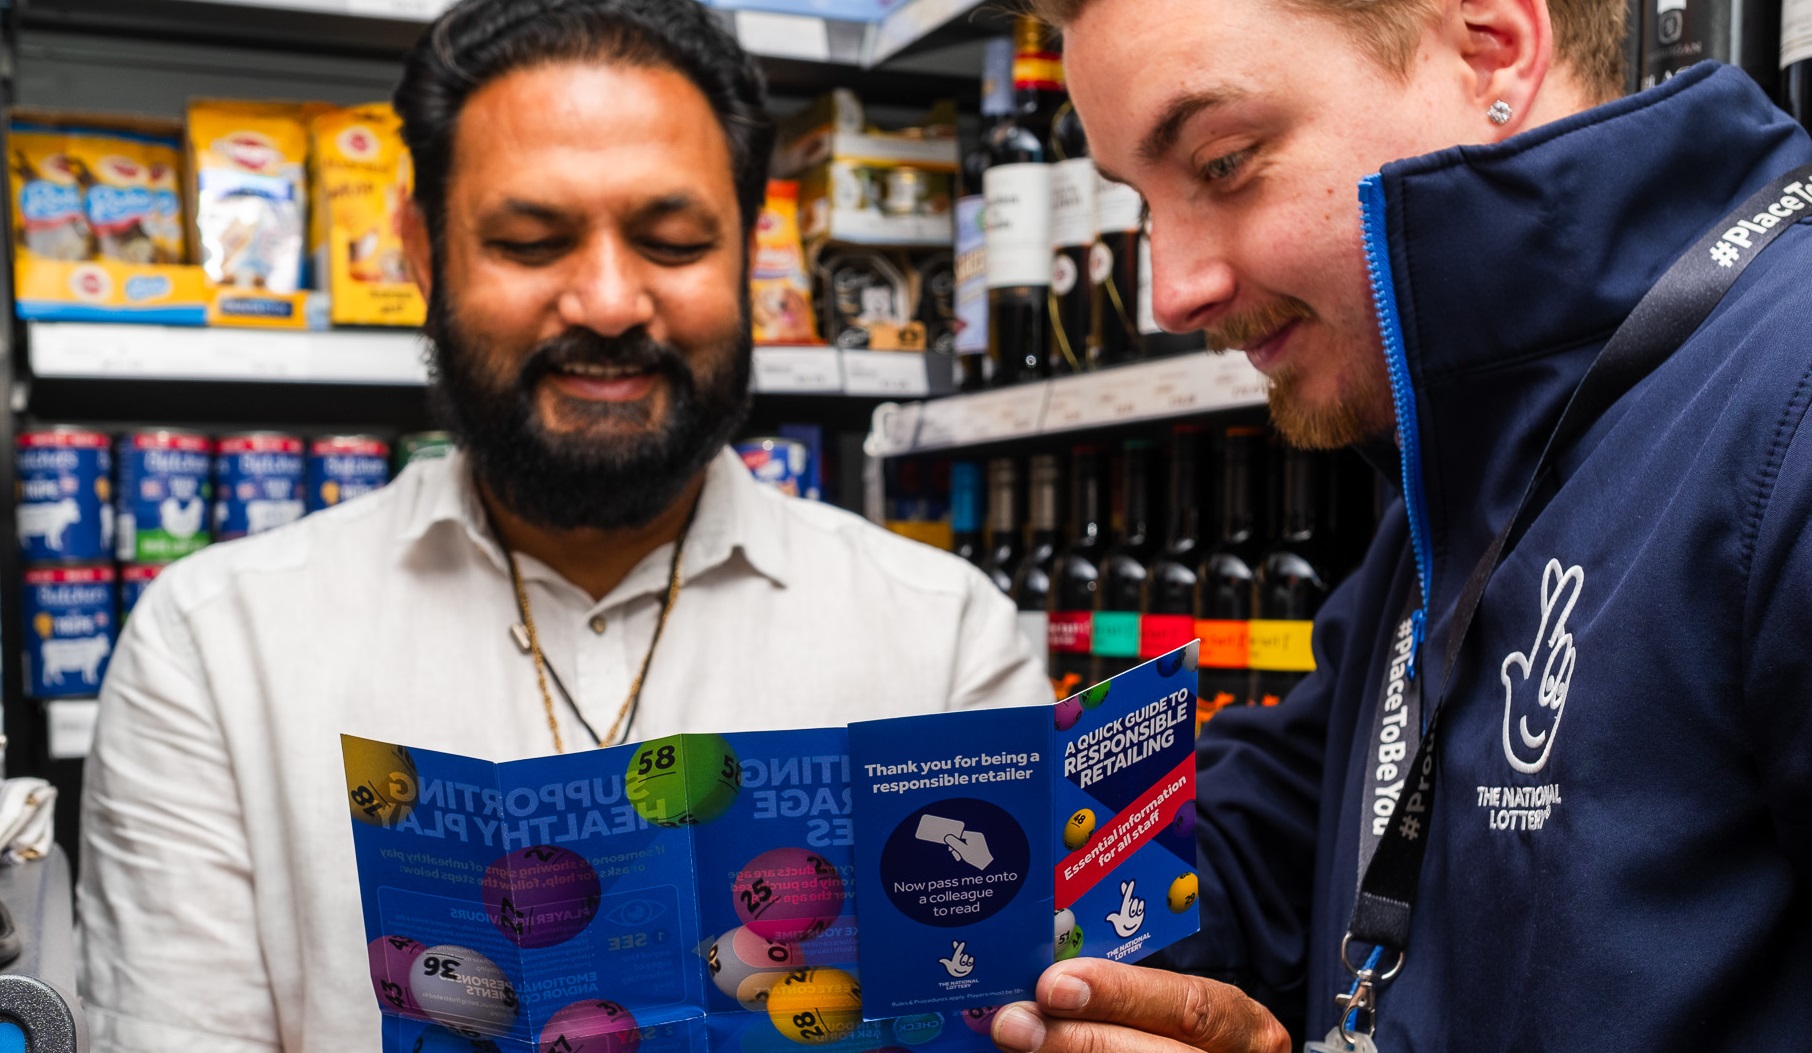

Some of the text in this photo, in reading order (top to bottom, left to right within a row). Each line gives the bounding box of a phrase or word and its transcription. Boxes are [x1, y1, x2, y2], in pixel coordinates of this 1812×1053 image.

[1064, 687, 1189, 757] A QUICK GUIDE TO
[1064, 702, 1188, 778] RESPONSIBLE
[637, 745, 676, 776] 58
[864, 751, 1041, 777] Thank you for being a
[1080, 728, 1175, 790] RETAILING
[872, 768, 1034, 794] responsible retailer
[350, 785, 384, 818] 18
[1476, 783, 1562, 808] THE NATIONAL
[1063, 775, 1187, 881] Essential information
[1073, 813, 1087, 825] 48
[1098, 808, 1160, 867] for all staff
[893, 871, 1019, 893] Now pass me onto
[740, 878, 772, 914] 25
[918, 888, 994, 905] a colleague
[933, 902, 980, 917] to read
[1106, 932, 1152, 959] THE NATIONAL
[1114, 942, 1144, 961] LOTTERY
[423, 956, 462, 980] 36
[945, 983, 972, 991] LOTTERY
[950, 978, 980, 986] NATIONAL
[792, 1011, 824, 1040] 28
